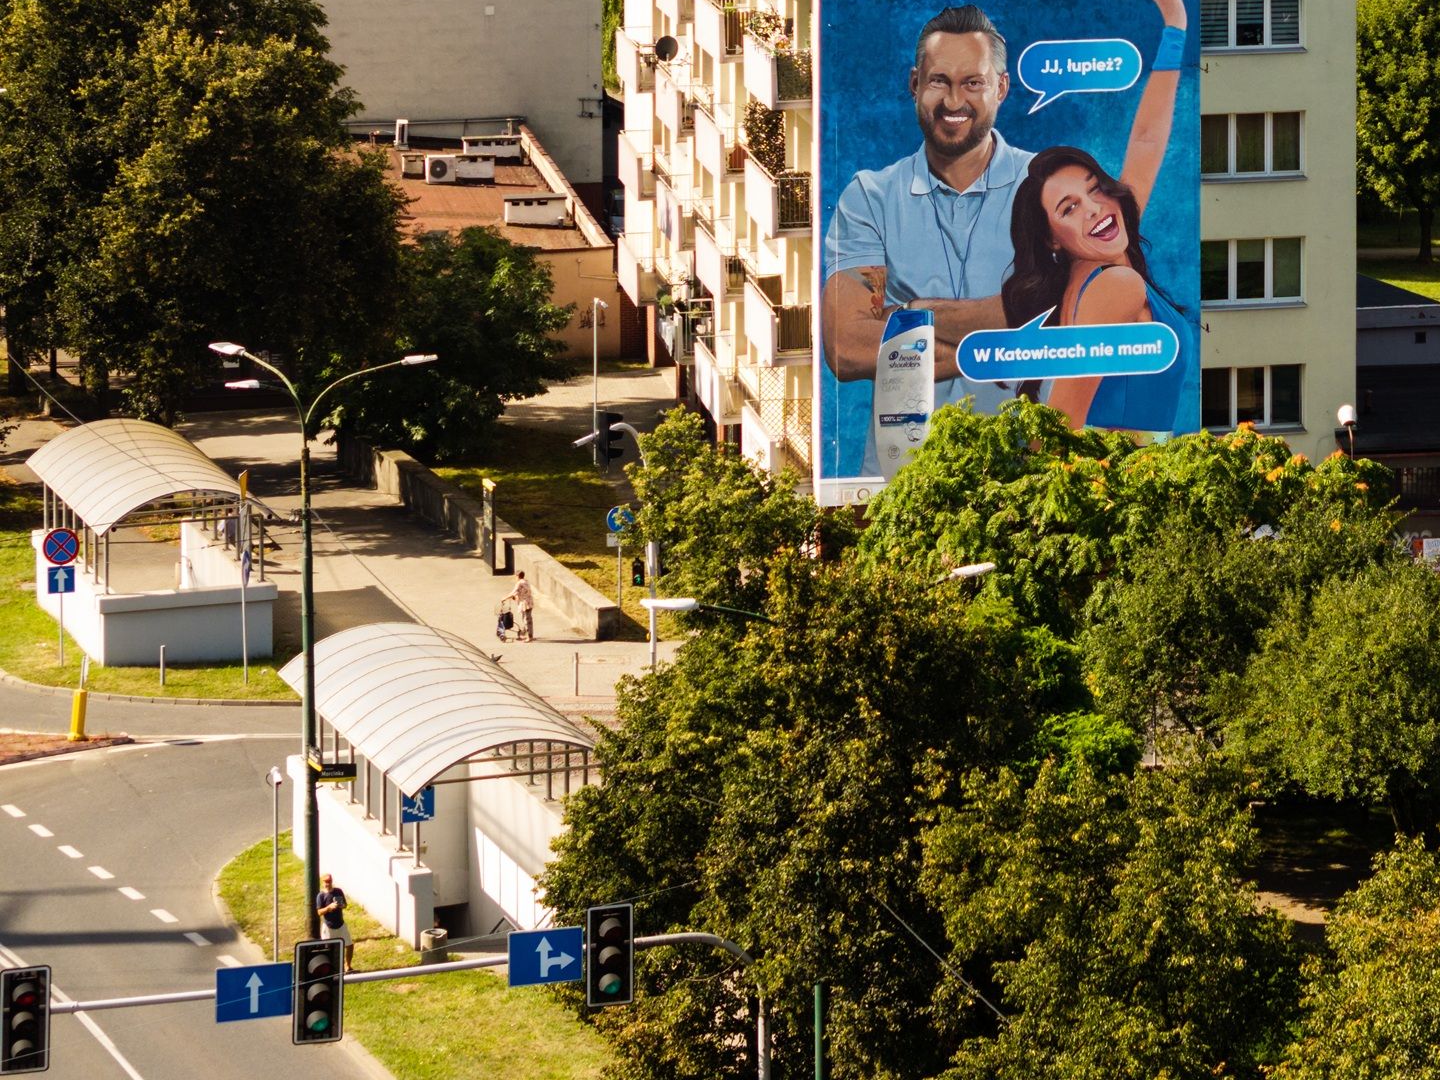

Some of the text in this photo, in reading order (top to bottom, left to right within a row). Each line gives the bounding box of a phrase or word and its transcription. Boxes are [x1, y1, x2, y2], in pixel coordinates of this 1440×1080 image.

[1041, 57, 1123, 76] JJ, łupież?
[973, 340, 1162, 362] W Katowicach nie mam!
